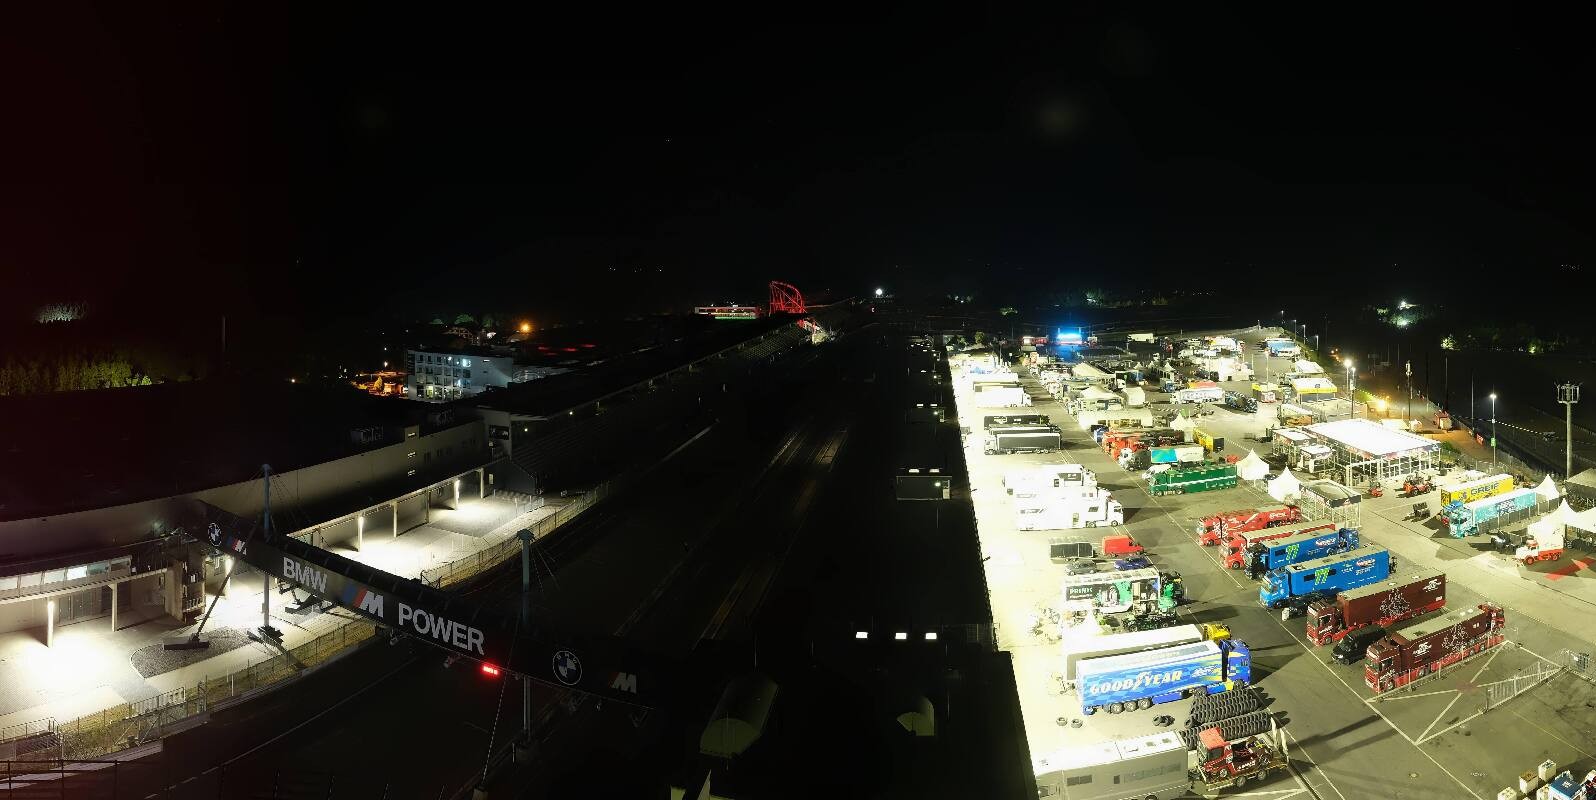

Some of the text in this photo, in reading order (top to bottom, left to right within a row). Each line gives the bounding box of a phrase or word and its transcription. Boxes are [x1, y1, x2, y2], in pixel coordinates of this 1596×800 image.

[1470, 482, 1499, 495] GREIF
[283, 556, 329, 593] BMW
[398, 603, 485, 655] POWER
